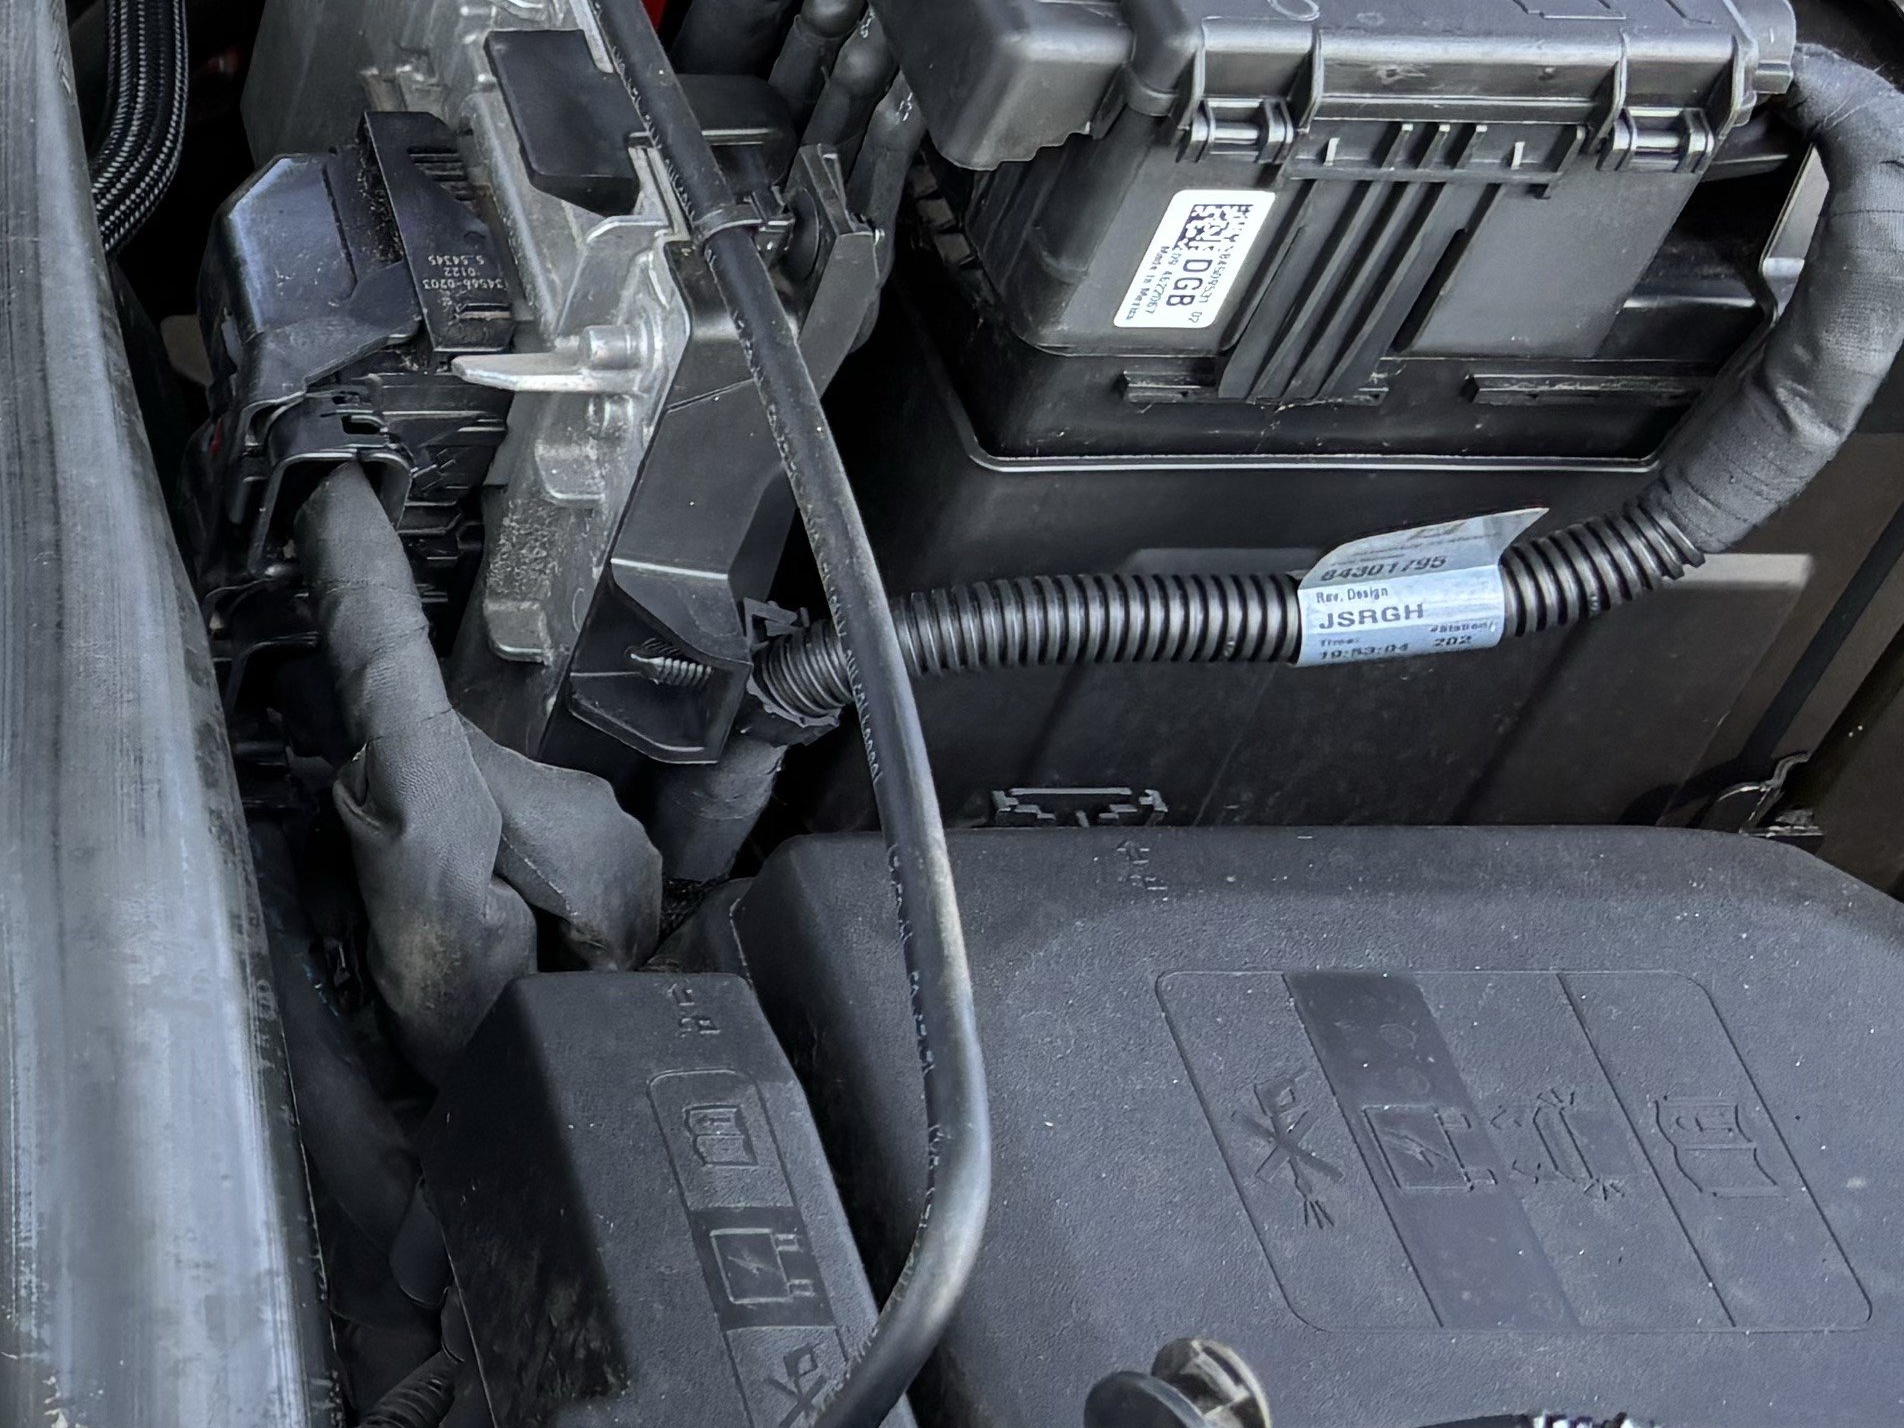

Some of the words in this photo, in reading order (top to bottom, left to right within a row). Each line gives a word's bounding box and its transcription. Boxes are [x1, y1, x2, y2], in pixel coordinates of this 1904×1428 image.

[1166, 259, 1213, 307] DGB
[1320, 554, 1448, 582] 84301795
[1347, 586, 1389, 602] Design
[1319, 602, 1424, 630] JSRGH
